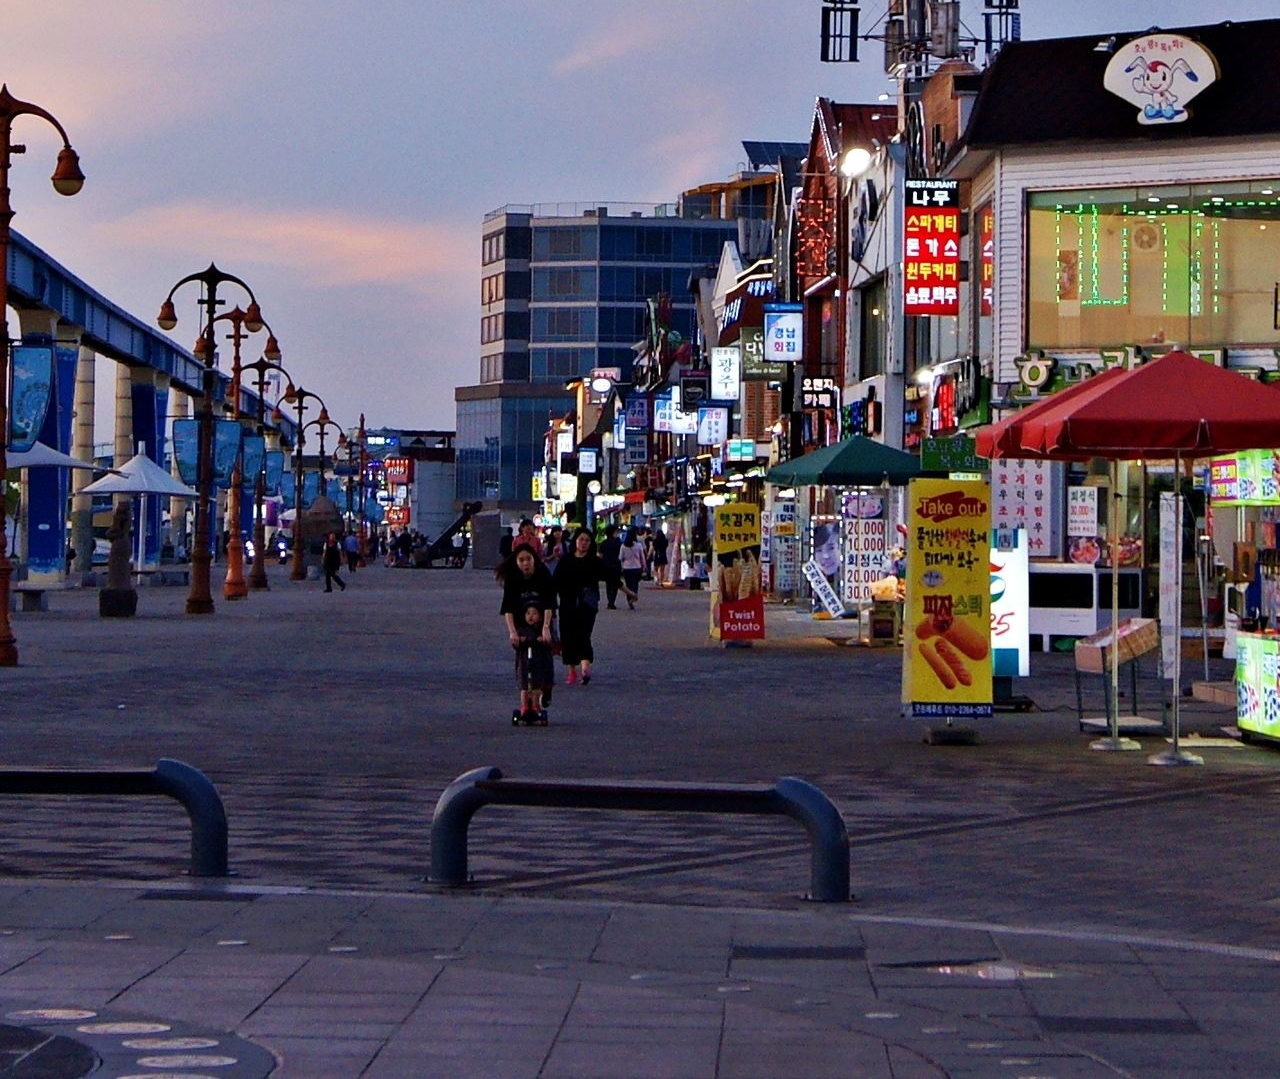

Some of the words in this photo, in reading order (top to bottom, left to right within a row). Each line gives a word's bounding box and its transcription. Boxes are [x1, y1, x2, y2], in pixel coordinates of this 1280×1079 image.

[906, 180, 958, 189] RESTAURANT
[912, 190, 951, 207] 나무
[906, 214, 958, 233] 스파게티
[906, 262, 957, 281] 원두커피
[716, 357, 736, 390] 광주
[802, 378, 833, 391] 오렌지
[920, 499, 954, 516] Take
[958, 501, 983, 516] out
[728, 609, 755, 620] Twist
[723, 622, 761, 632] Potato
